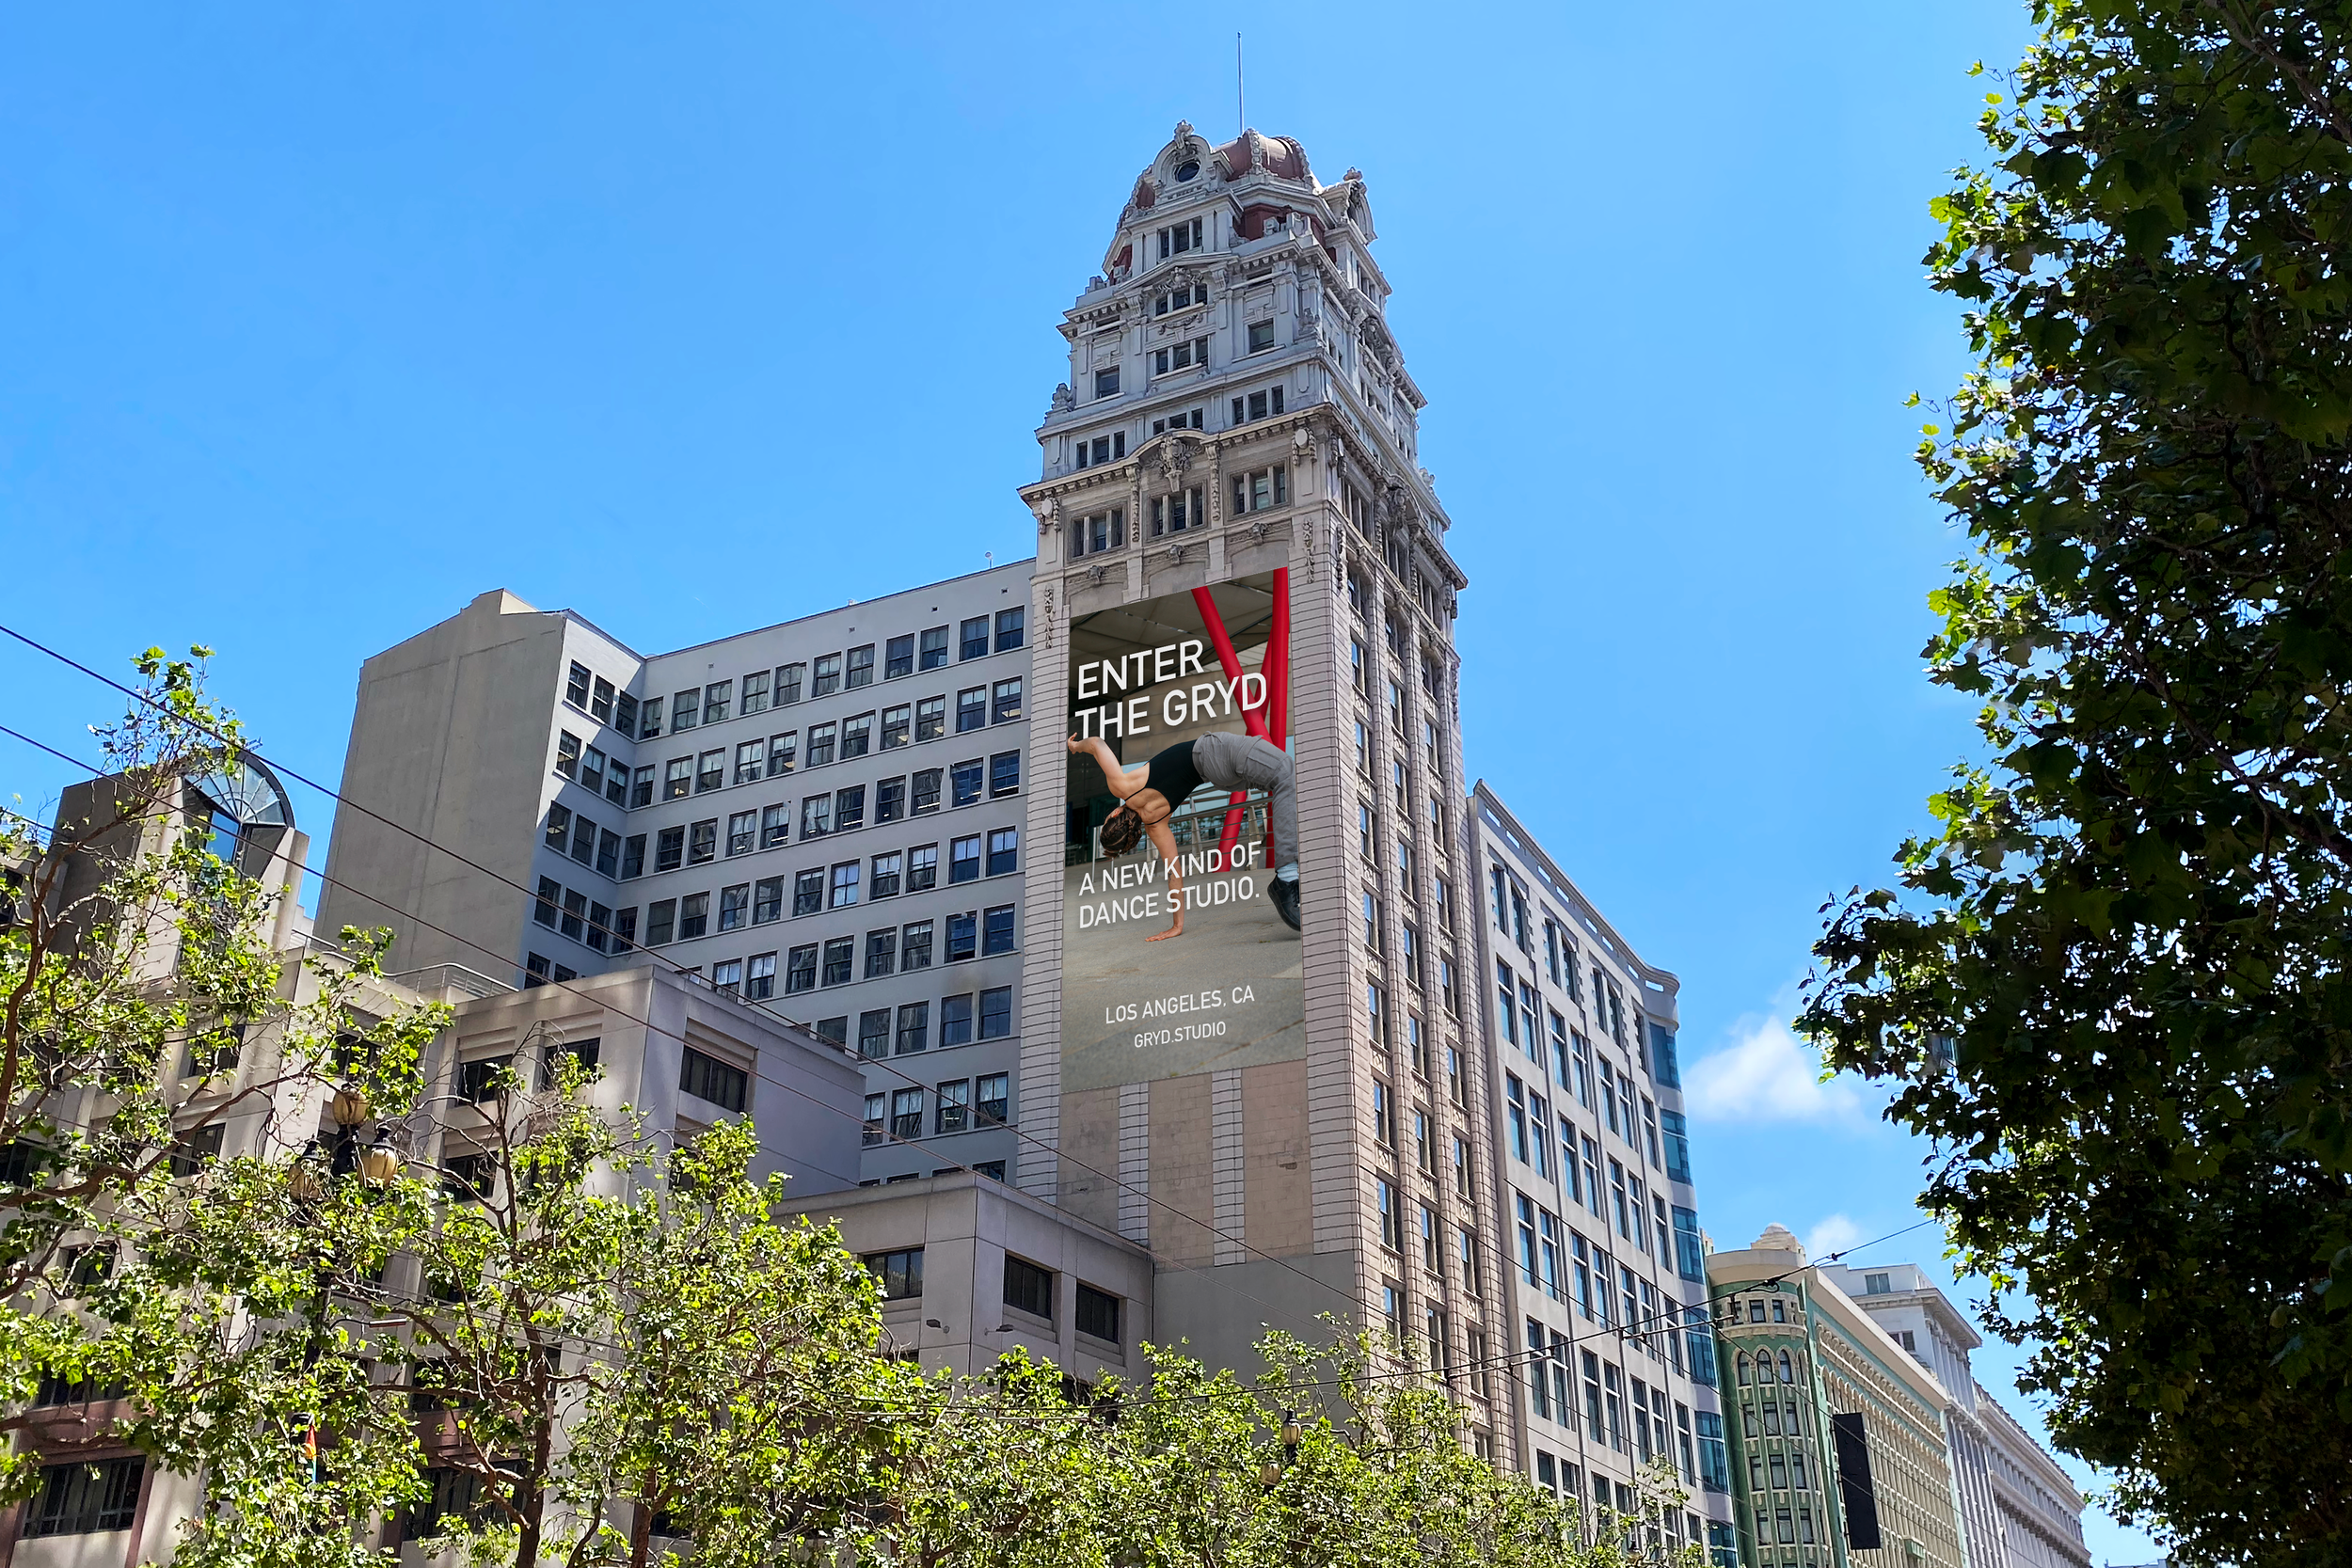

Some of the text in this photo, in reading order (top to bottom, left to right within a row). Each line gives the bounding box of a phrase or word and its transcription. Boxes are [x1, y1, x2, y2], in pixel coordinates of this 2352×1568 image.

[1078, 639, 1204, 700] ENTER
[1074, 672, 1267, 740] THE GRYD
[1078, 840, 1262, 896] A NEW KIND OF
[1079, 876, 1260, 929] DANCE STUDIO.
[1105, 985, 1255, 1024] LOS ANGELES, CA
[1135, 1021, 1226, 1048] GRYD.STUDIO
